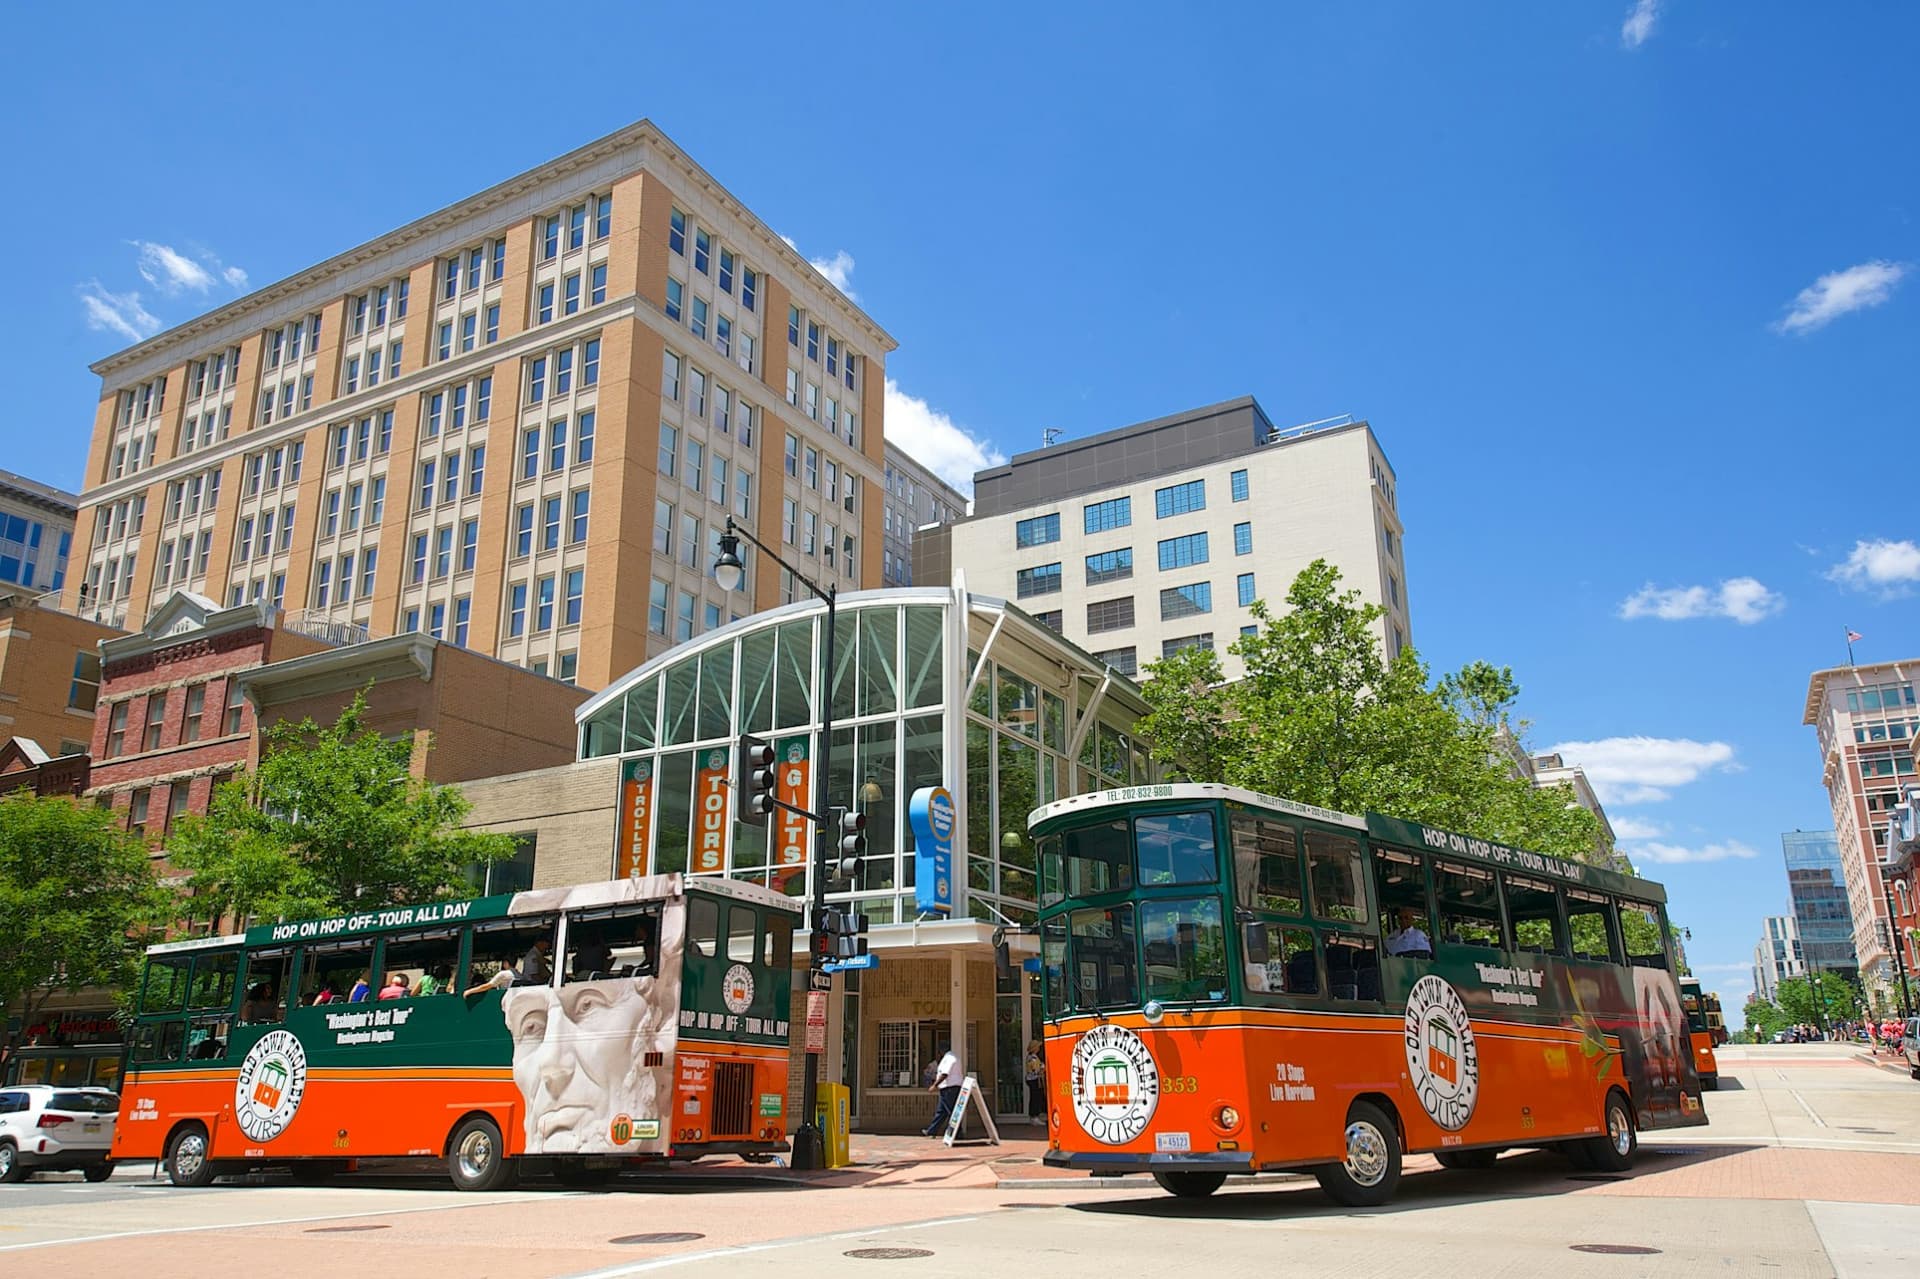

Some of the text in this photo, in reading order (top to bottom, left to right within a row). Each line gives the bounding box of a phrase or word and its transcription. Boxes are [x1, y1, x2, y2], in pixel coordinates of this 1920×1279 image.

[630, 783, 646, 879] TROLLEYS
[702, 775, 724, 868] TOURS
[1422, 827, 1447, 848] HOP
[1450, 834, 1467, 854] ON
[1468, 838, 1490, 859] HOP
[1546, 857, 1563, 876] ALL
[1563, 861, 1581, 880] DAY
[272, 924, 298, 940] HOP
[300, 922, 317, 937] ON
[319, 918, 346, 935] HOP
[415, 904, 440, 922] ALL
[443, 902, 471, 919] DAY
[680, 1009, 789, 1037] HOP ON HOP OFF TOUR ALL DAY
[1406, 977, 1477, 1085] OLD TOWN TROLLEY
[240, 1032, 305, 1109] OLD TOWN TROLLEY
[1074, 1027, 1108, 1063] TOWN
[1113, 1027, 1157, 1095] TROLLEY
[1162, 1076, 1198, 1094] 353
[237, 1096, 282, 1140] TOURS
[1082, 1105, 1147, 1143] TOURS
[1416, 1066, 1470, 1129] TOURS
[613, 1122, 629, 1140] 10
